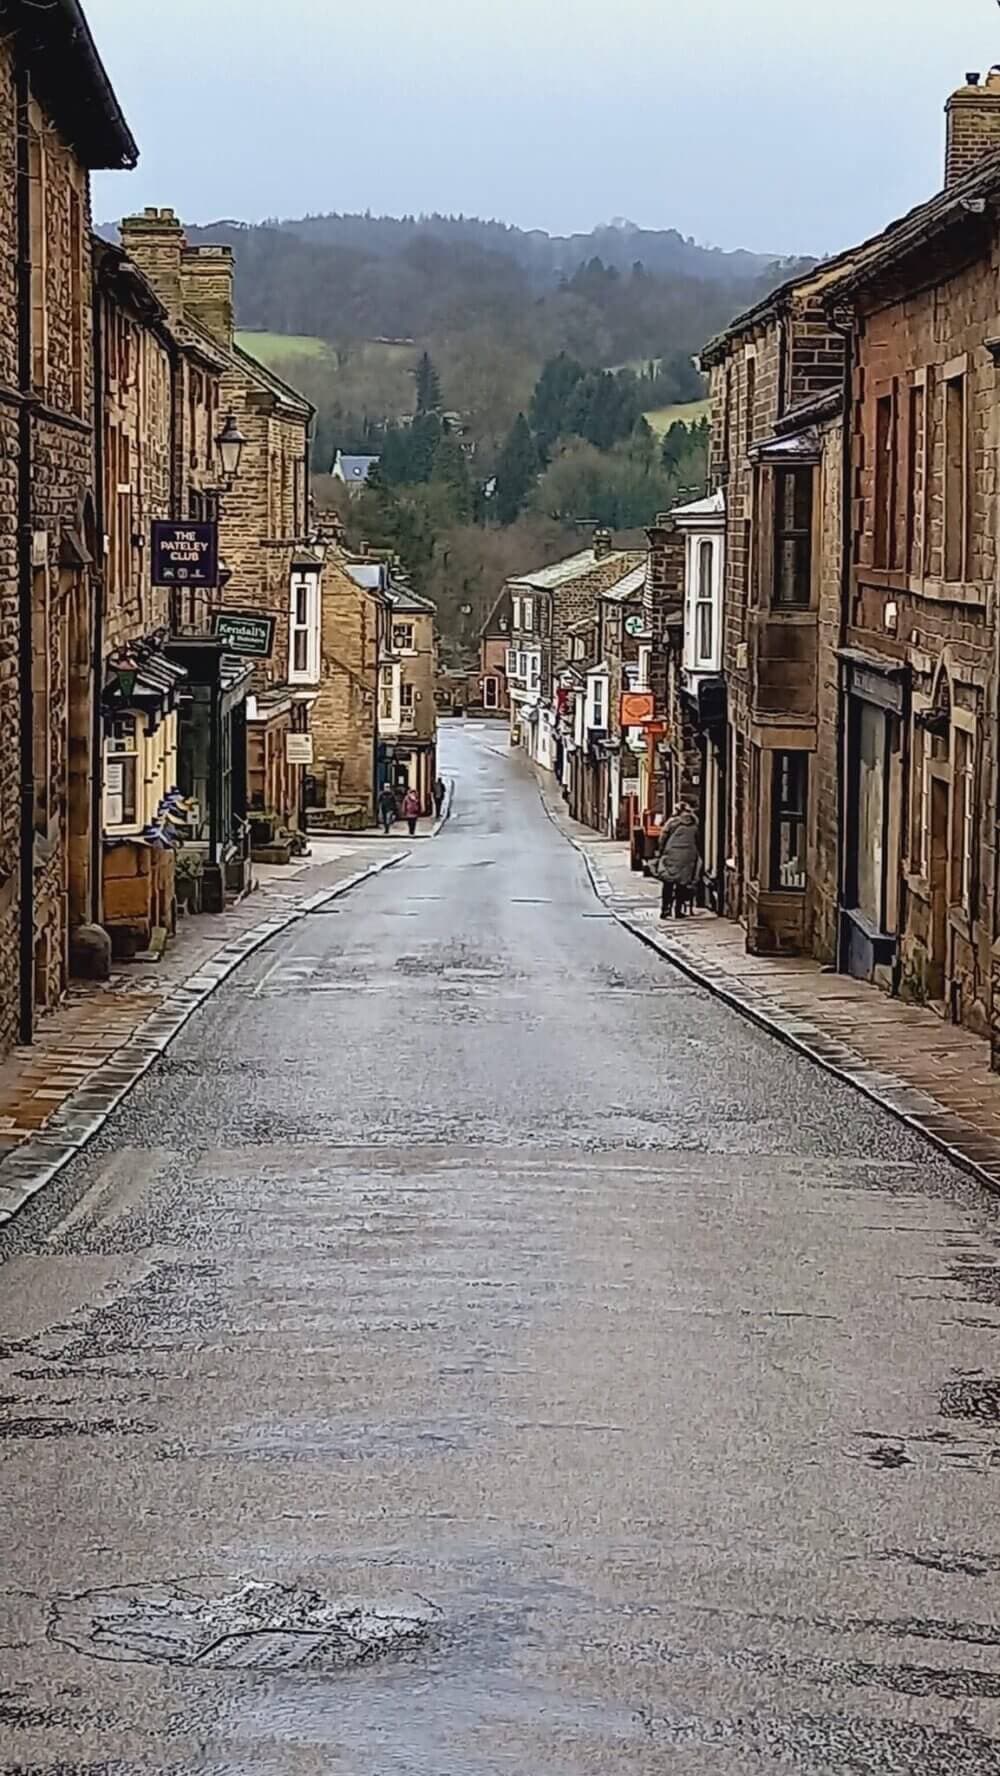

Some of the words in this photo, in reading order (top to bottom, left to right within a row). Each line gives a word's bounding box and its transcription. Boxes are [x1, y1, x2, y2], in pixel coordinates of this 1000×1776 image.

[174, 531, 196, 541] THE
[160, 541, 208, 552] PATELEY
[170, 551, 199, 561] CLUB
[219, 623, 266, 638] Kendall's
